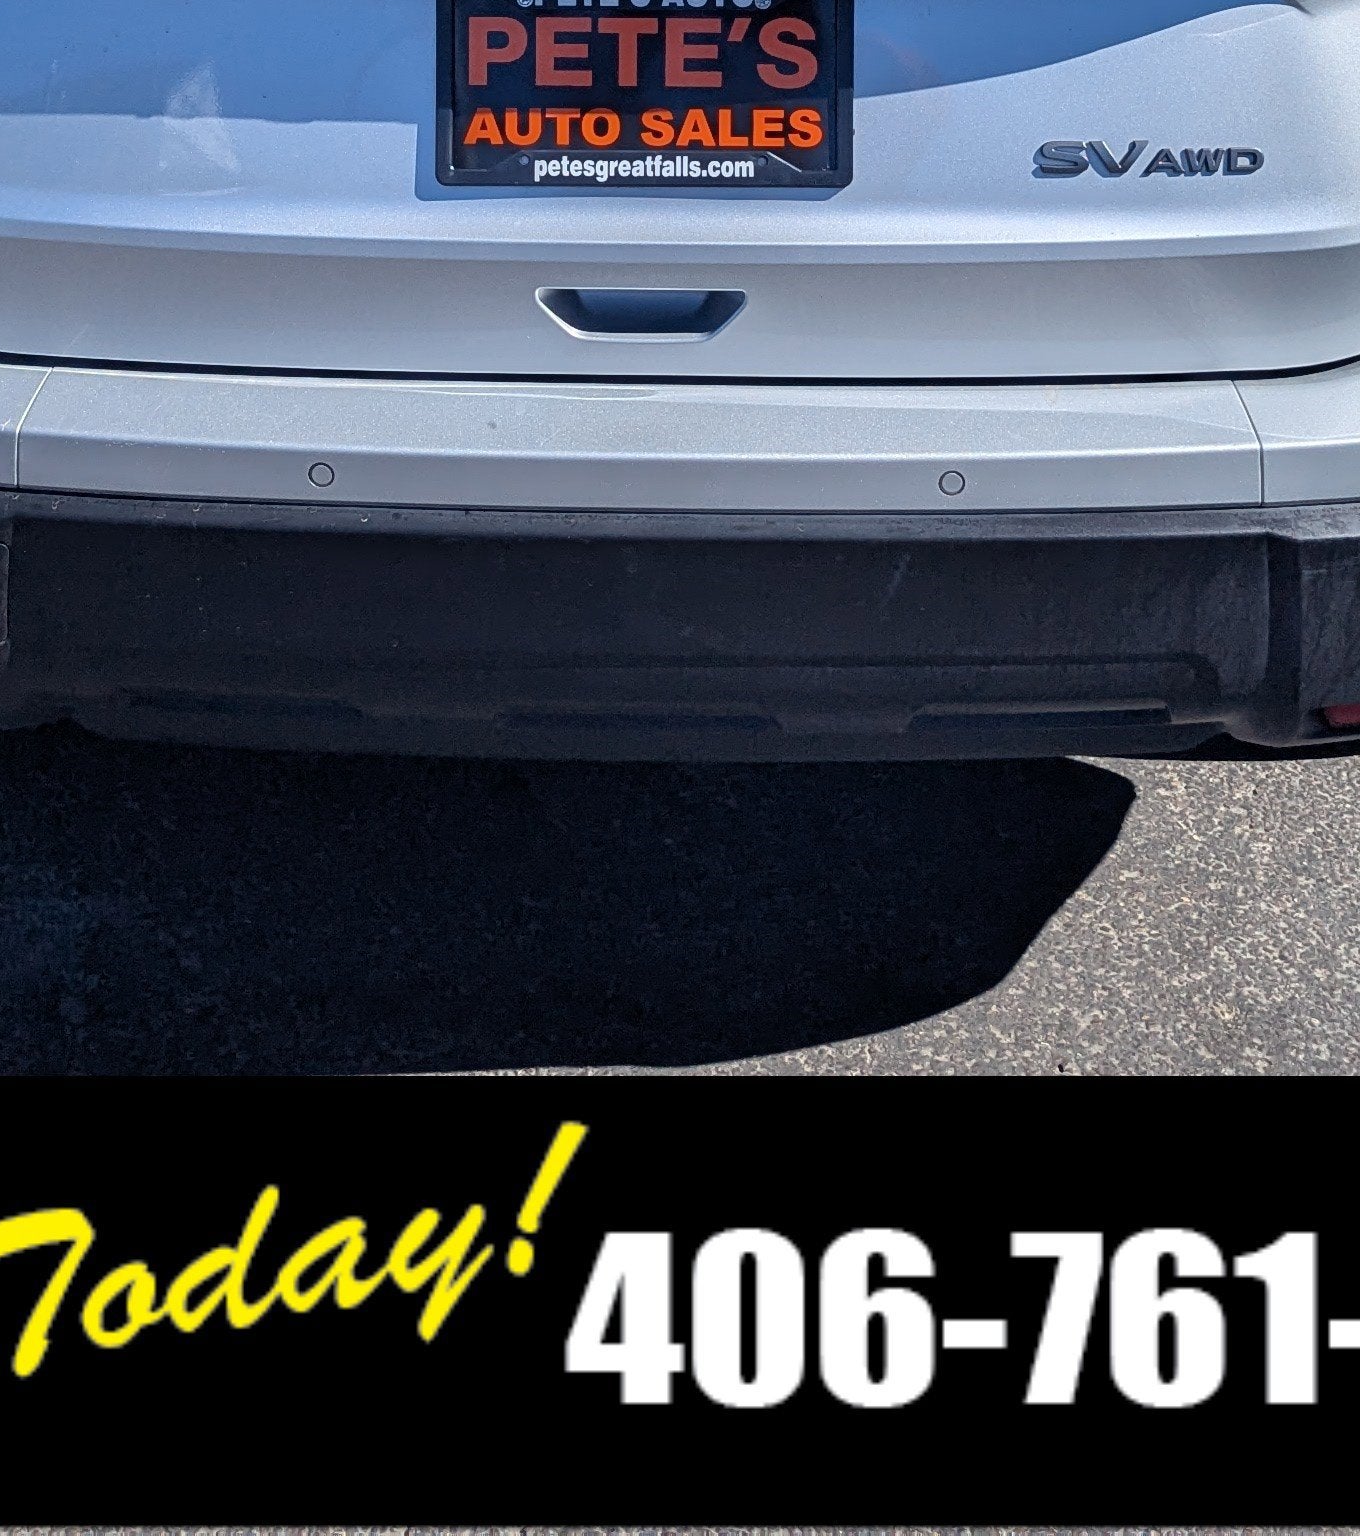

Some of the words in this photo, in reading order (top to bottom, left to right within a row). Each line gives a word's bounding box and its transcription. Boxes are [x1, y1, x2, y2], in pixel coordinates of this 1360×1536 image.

[467, 16, 819, 90] PETE'S
[463, 107, 621, 147] AUTO
[639, 107, 823, 148] SALES
[533, 153, 755, 183] petesgreatfalls.com
[1039, 140, 1149, 175] SV
[1140, 147, 1265, 177] AWD
